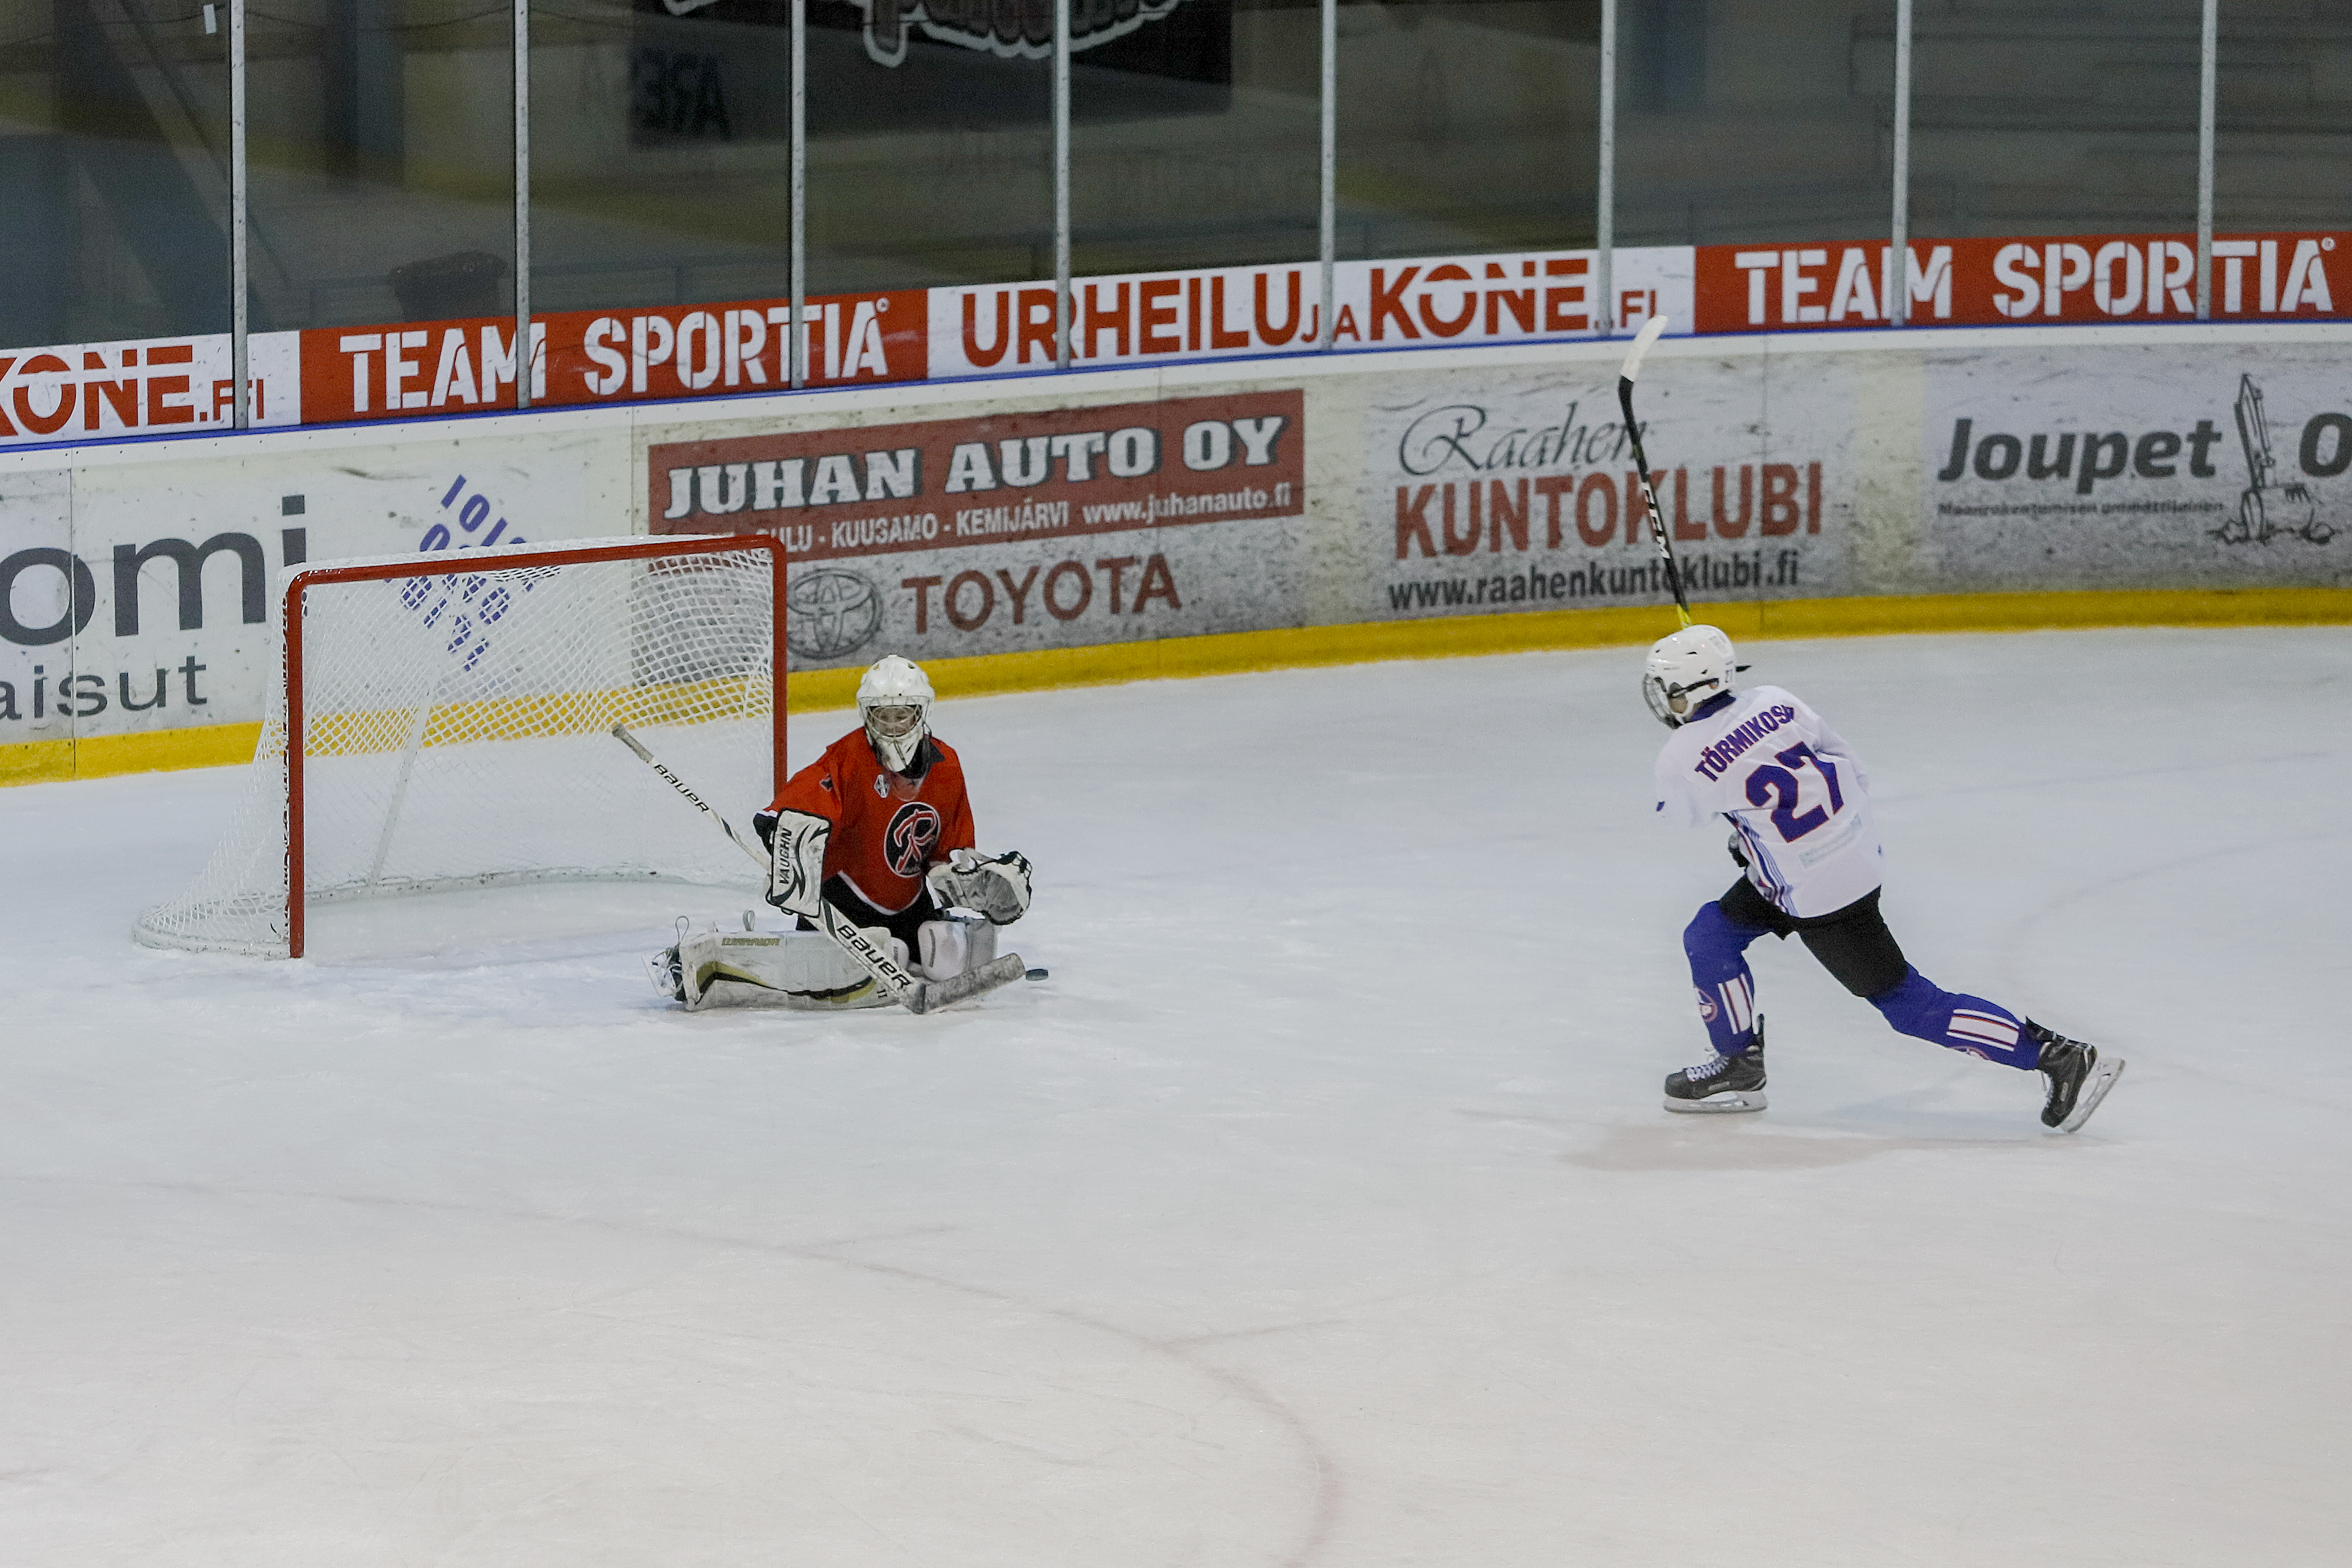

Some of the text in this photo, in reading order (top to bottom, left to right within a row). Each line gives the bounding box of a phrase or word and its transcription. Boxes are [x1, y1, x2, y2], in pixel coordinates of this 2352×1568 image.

[962, 271, 1301, 367] URHEILU
[1735, 240, 2333, 325] TEAM SPORTIA
[340, 300, 888, 413] TEAM SPORTIA
[664, 417, 1285, 519] JUHAN AUTO OY
[1399, 400, 1647, 475] Raahen
[1938, 417, 2222, 494] Joupet
[832, 512, 939, 548] KUUSAMO
[956, 497, 1069, 537] KEMIJÄRVI
[1082, 482, 1292, 524] www.juhanauto.fi
[1396, 461, 1823, 560] KUNTOKLUBI
[901, 554, 1182, 635] TOYOTA
[653, 763, 710, 812] BAUER
[1745, 741, 1844, 844] 27
[779, 828, 792, 885] VAUGHN
[837, 924, 912, 990] BAUER
